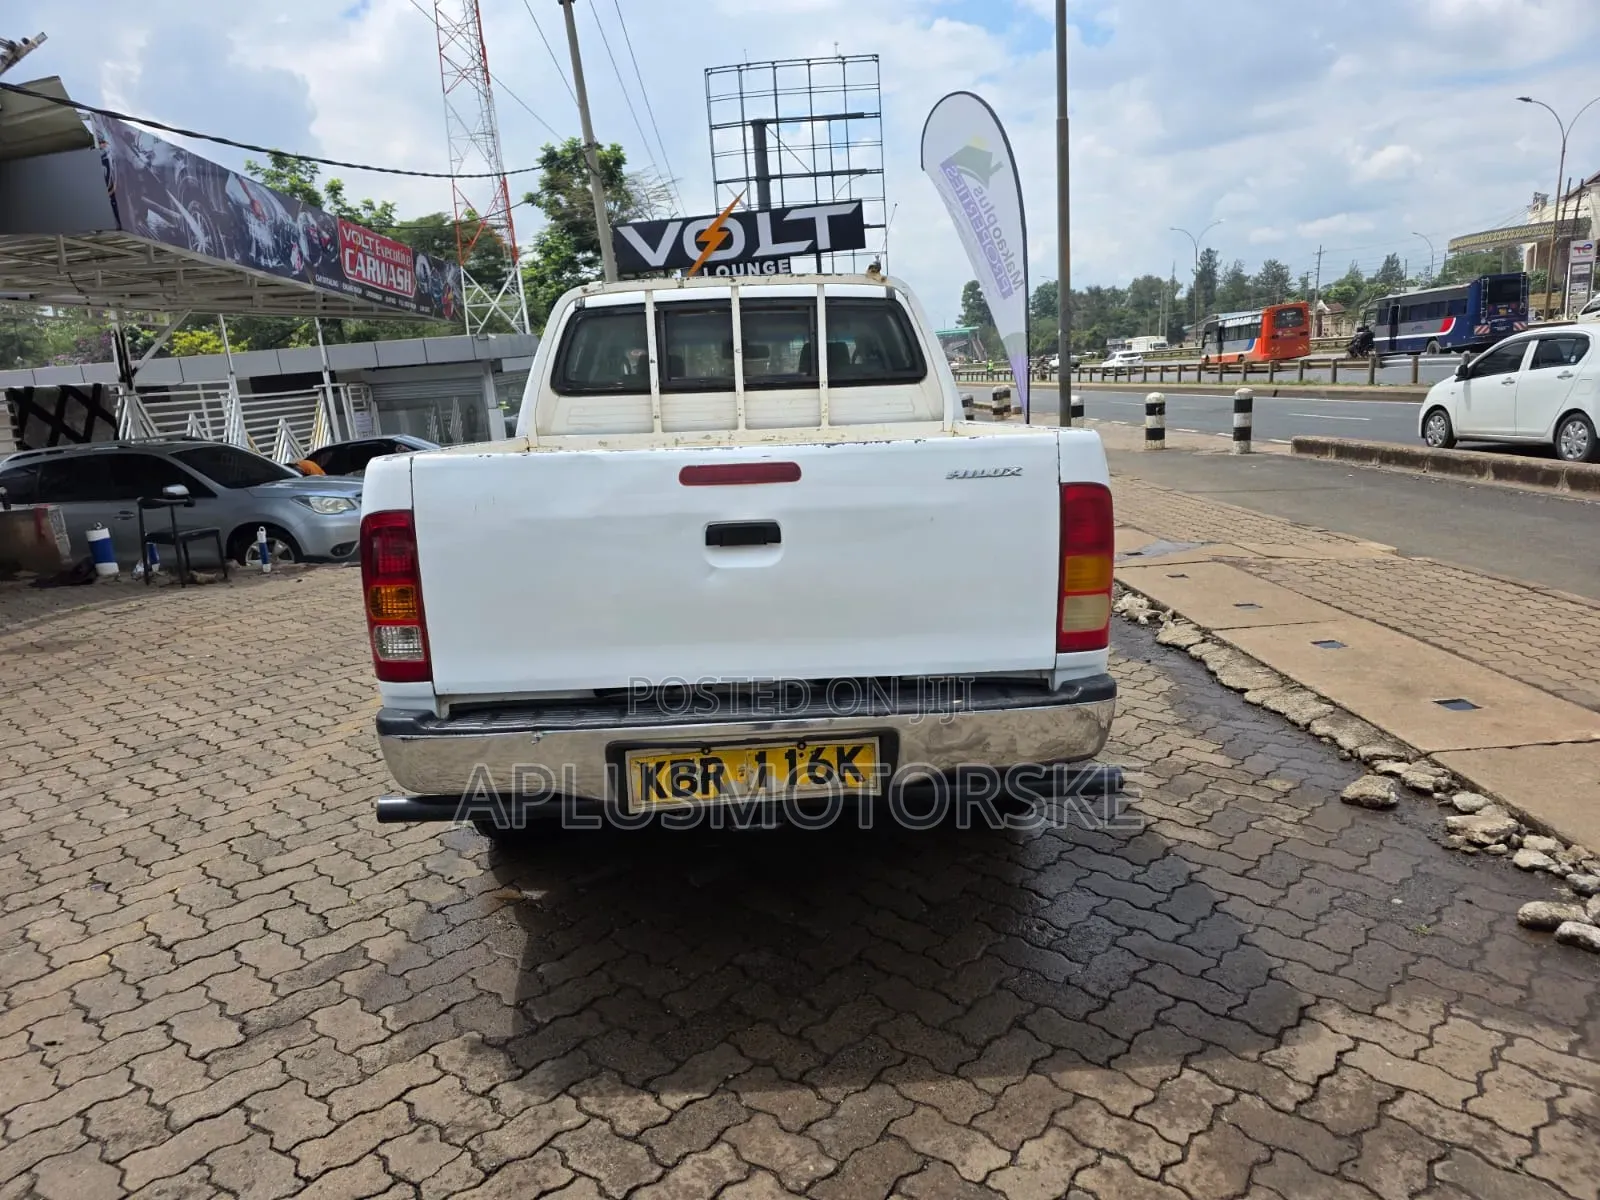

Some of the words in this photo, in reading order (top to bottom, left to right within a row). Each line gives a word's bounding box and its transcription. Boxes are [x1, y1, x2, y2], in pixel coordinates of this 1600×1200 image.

[342, 226, 374, 250] VOLT
[616, 201, 861, 267] VOLT
[344, 247, 412, 293] CARWASH
[703, 259, 791, 276] LOUNGE
[640, 756, 725, 799] KBR
[754, 745, 866, 794] 116K
